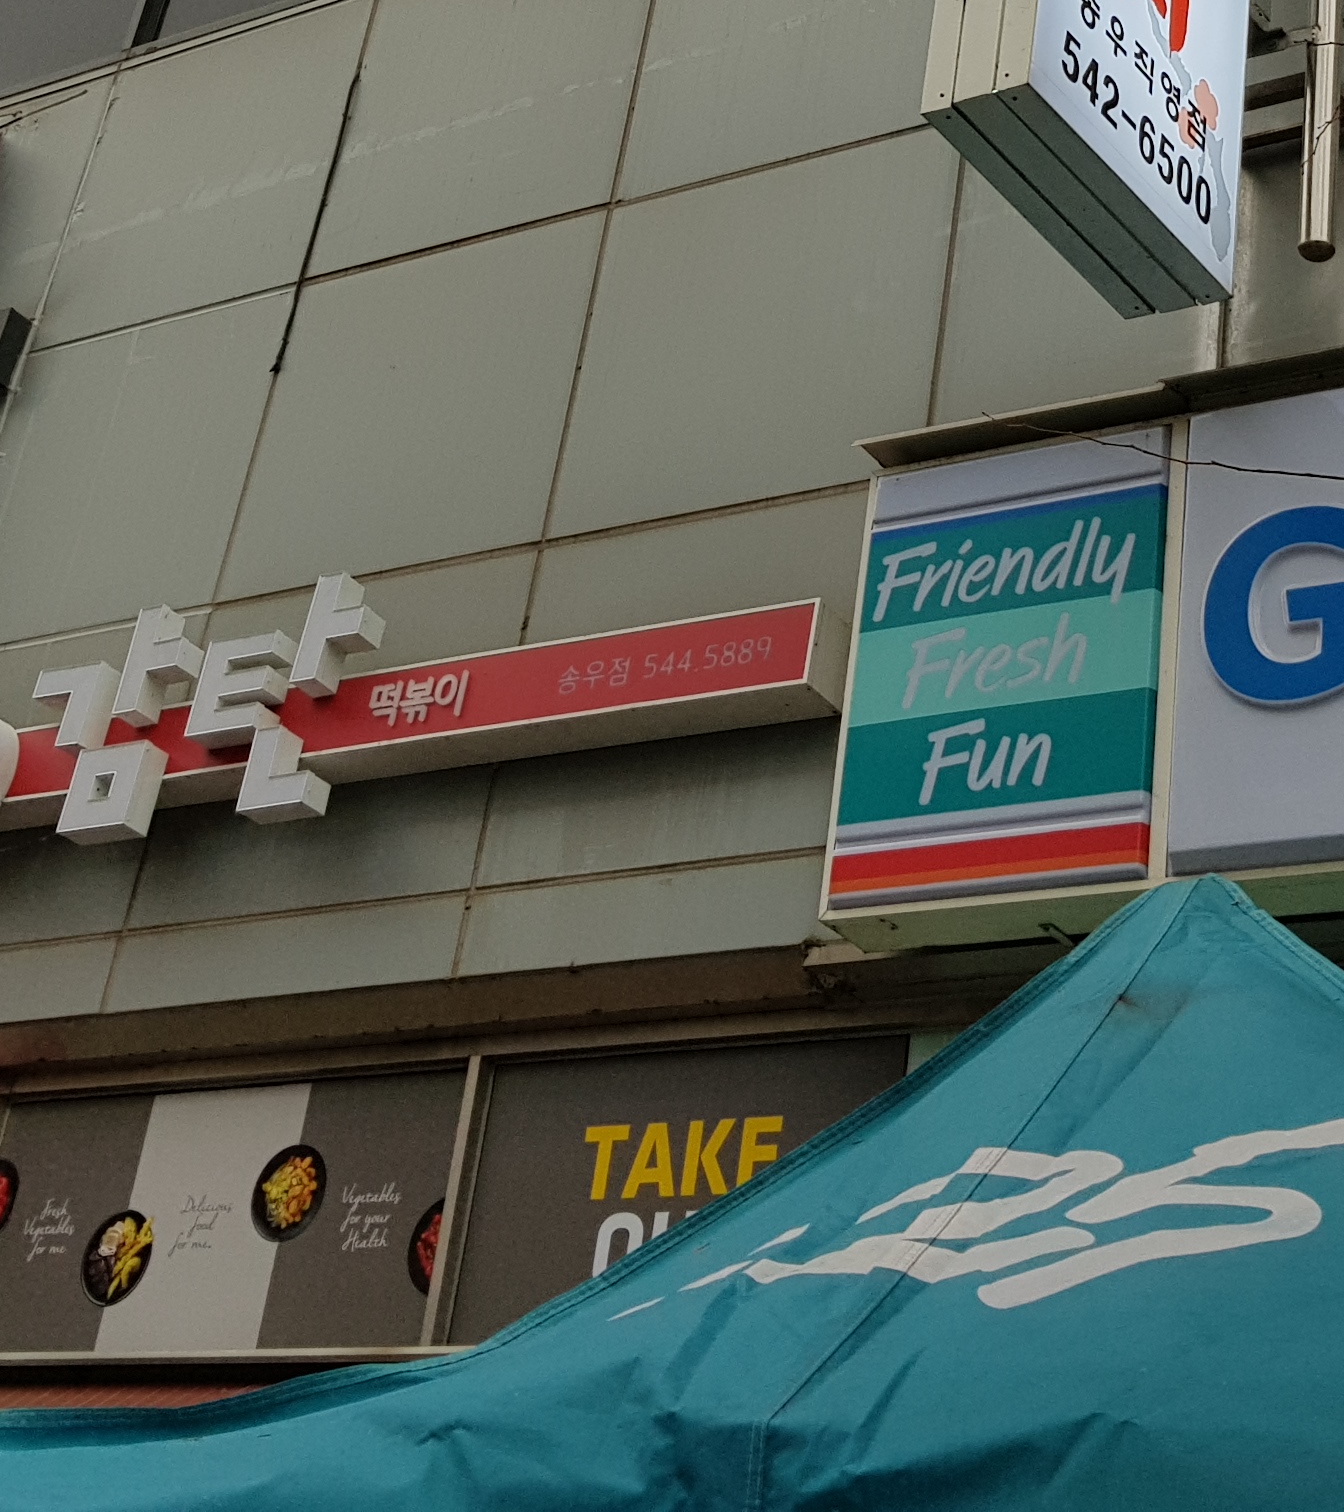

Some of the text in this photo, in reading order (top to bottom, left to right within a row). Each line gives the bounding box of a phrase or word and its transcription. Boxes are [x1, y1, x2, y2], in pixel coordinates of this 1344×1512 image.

[1060, 30, 1213, 226] 542-6500
[871, 516, 1137, 623] Friendly
[900, 612, 1090, 710] Fresh
[32, 572, 774, 840] 감탄 떡볶이 송우점 544.5889
[917, 718, 1054, 806] Fun
[342, 1181, 402, 1212] Vegetables
[584, 1115, 784, 1201] TAKE
[341, 1227, 388, 1253] Health
[362, 1214, 392, 1234] your
